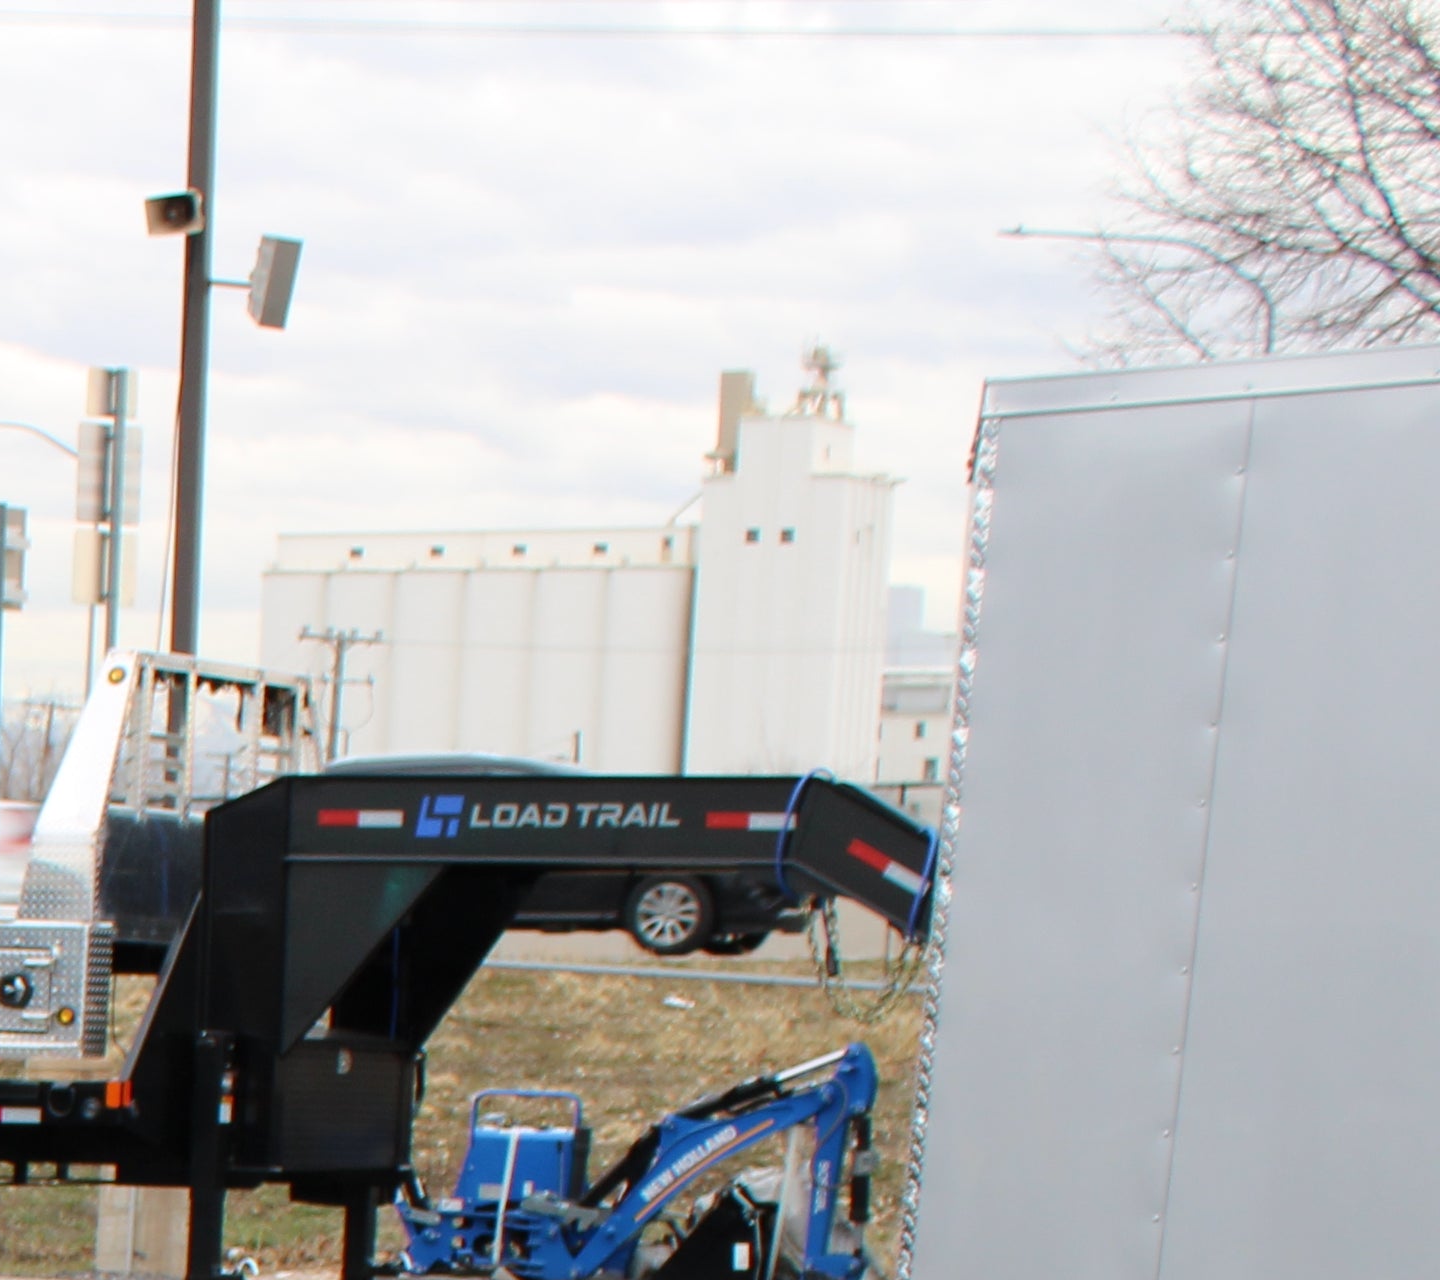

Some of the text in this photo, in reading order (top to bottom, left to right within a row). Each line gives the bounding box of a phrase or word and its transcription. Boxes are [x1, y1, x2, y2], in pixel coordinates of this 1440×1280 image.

[469, 802, 681, 829] LOAD TRAIL
[672, 1124, 739, 1177] HOLLAND
